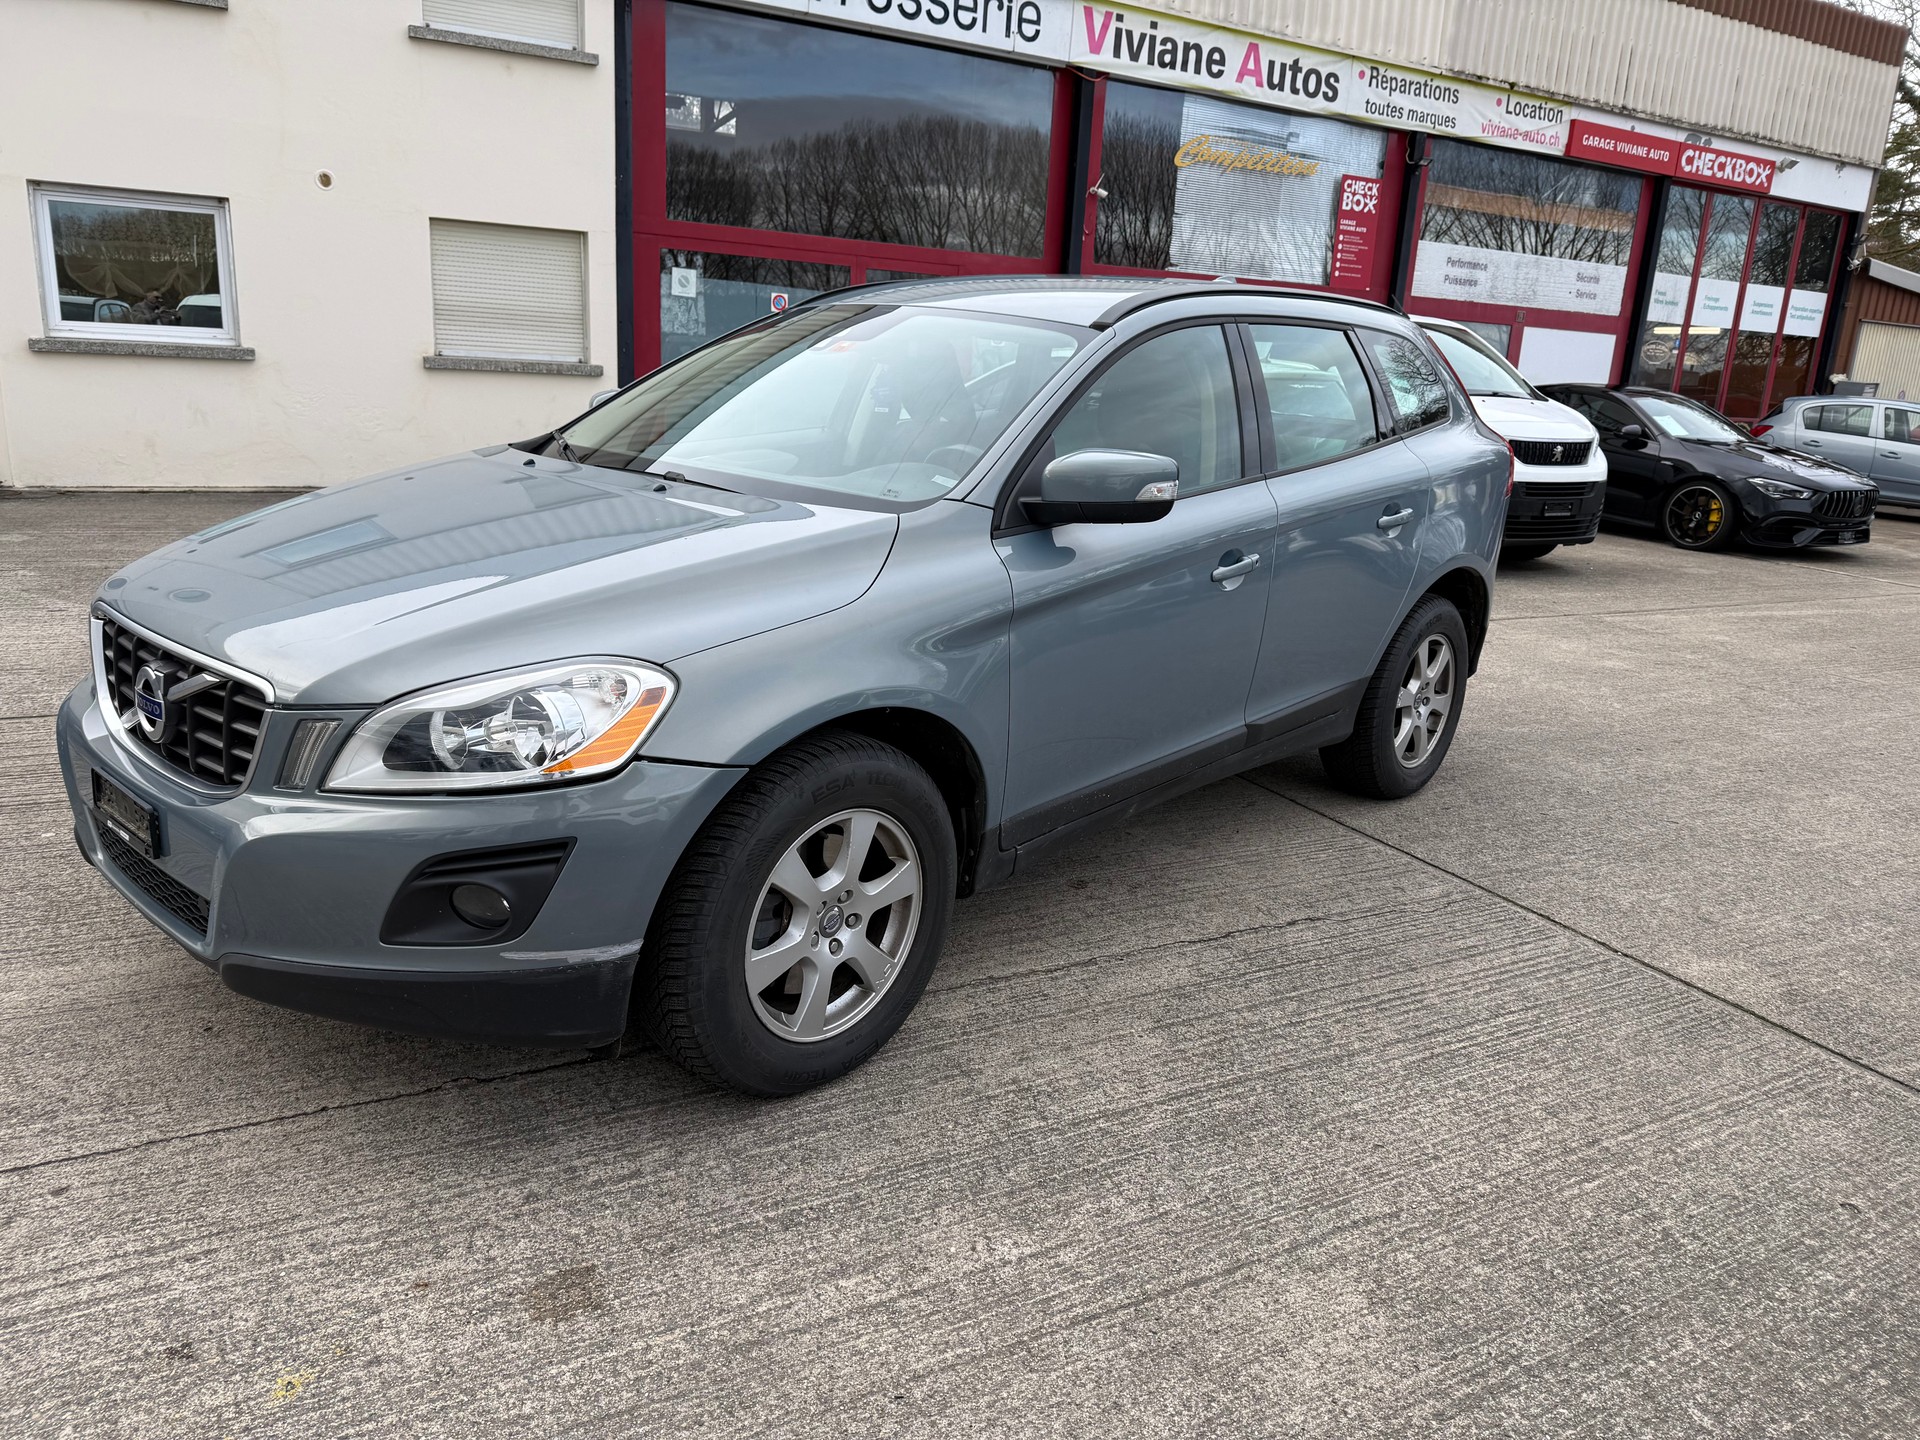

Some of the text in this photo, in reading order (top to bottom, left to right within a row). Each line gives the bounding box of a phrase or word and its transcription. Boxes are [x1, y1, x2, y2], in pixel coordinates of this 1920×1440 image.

[1083, 5, 1340, 103] Viviane Autos
[1368, 66, 1460, 105] Réparations
[1365, 98, 1457, 130] toutes marques
[1505, 94, 1564, 124] Location
[1481, 119, 1561, 147] viviane-auto.ch
[1582, 134, 1670, 162] GARAGE VIVIANE AUTO
[1681, 149, 1771, 187] CHECKBOX
[1344, 179, 1380, 196] CHECK
[1342, 192, 1378, 214] BOX
[1446, 256, 1488, 271] Performance
[1443, 274, 1478, 287] Puissance
[1575, 288, 1597, 300] Service
